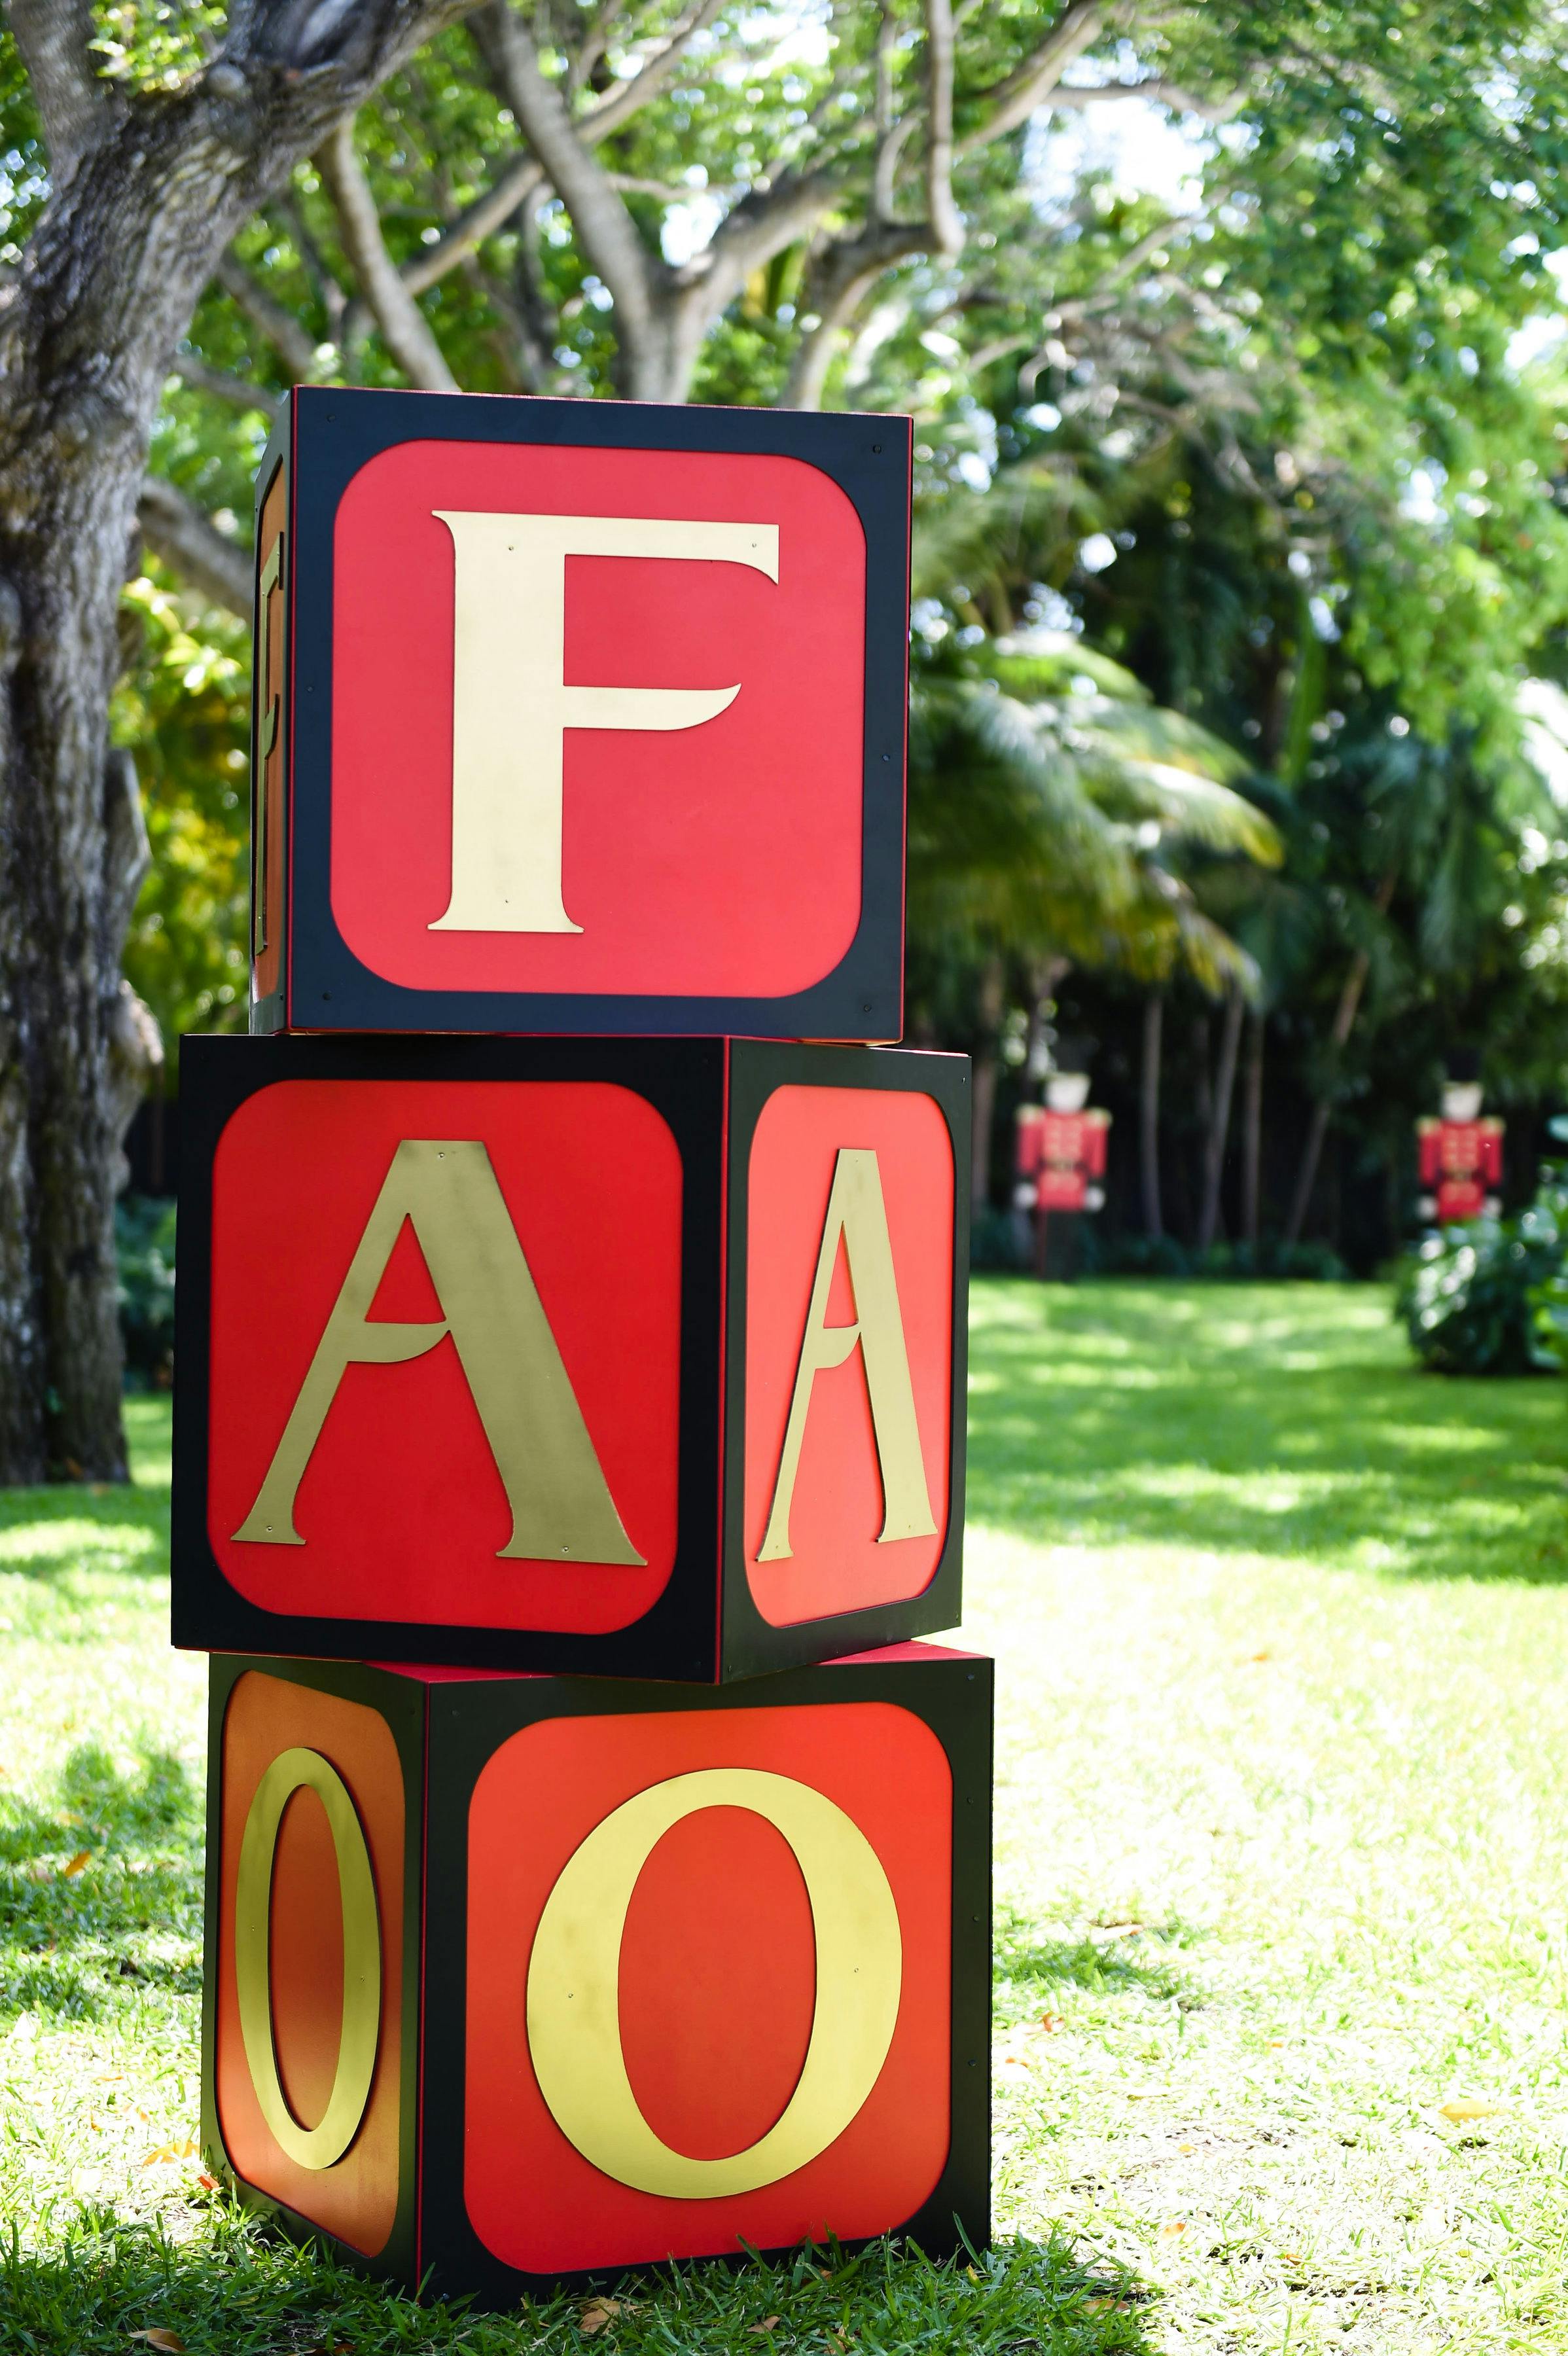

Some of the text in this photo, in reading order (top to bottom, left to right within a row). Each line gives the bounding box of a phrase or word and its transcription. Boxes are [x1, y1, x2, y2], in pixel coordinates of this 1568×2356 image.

[427, 510, 779, 933] F
[231, 1139, 648, 1565] A
[754, 1149, 938, 1562] A
[527, 1768, 902, 2200] O
